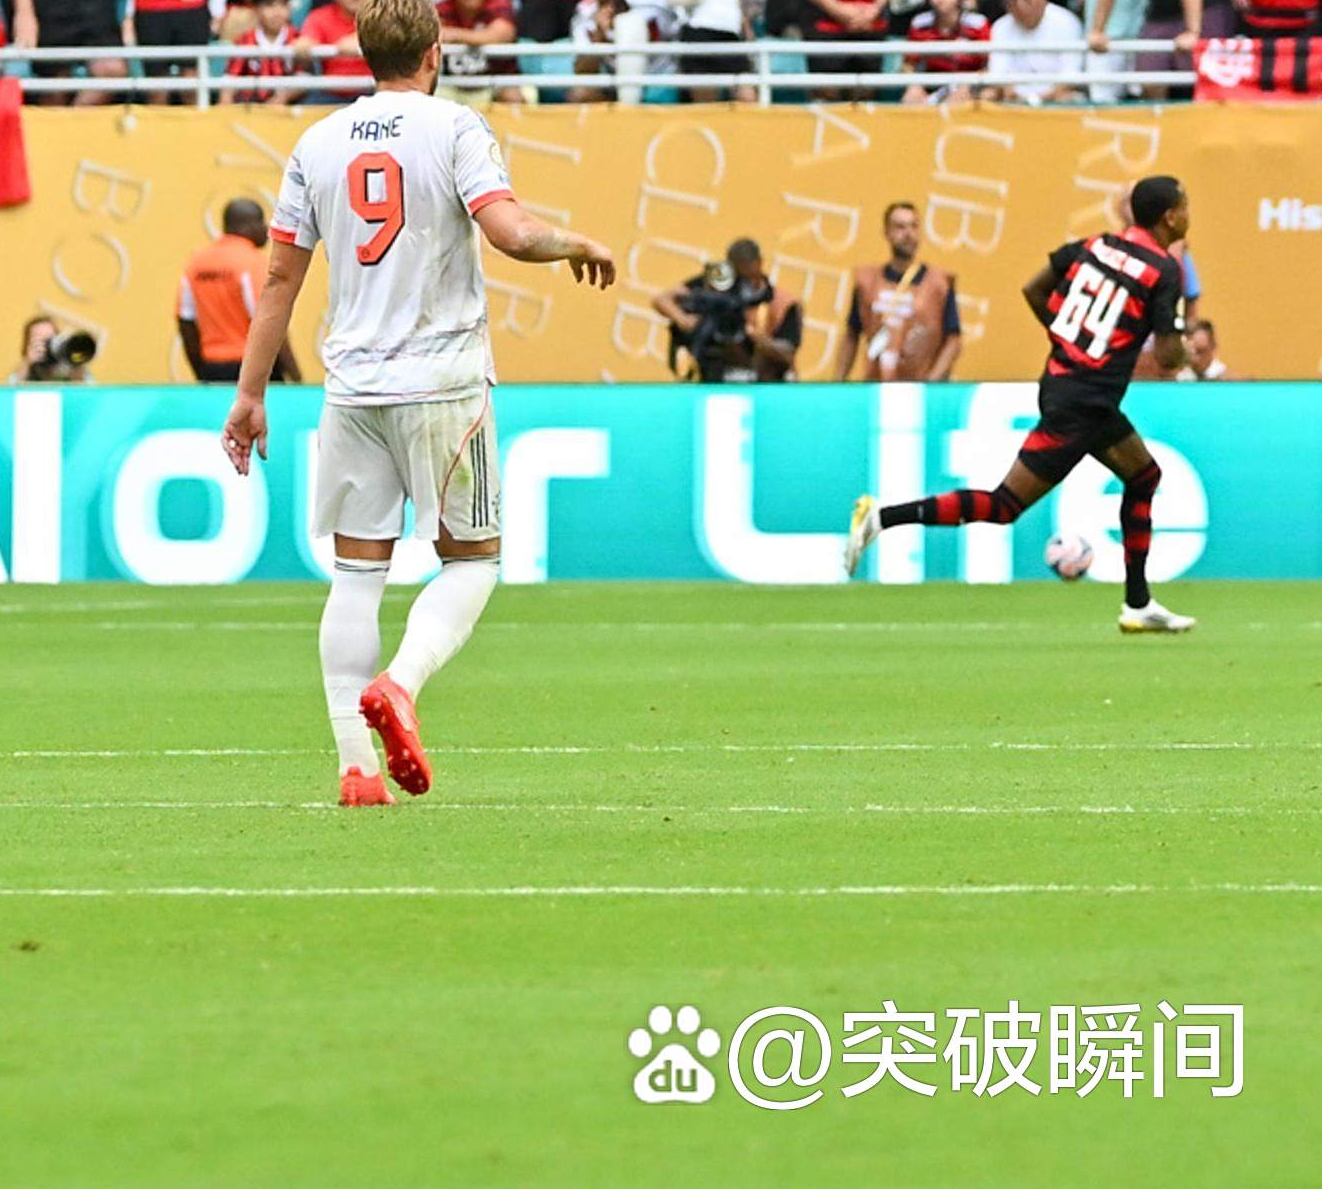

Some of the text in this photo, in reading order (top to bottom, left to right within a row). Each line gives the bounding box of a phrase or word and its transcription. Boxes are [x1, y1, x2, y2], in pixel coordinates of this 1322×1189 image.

[349, 114, 404, 141] KANE
[346, 150, 406, 267] 9
[1049, 261, 1130, 360] 64
